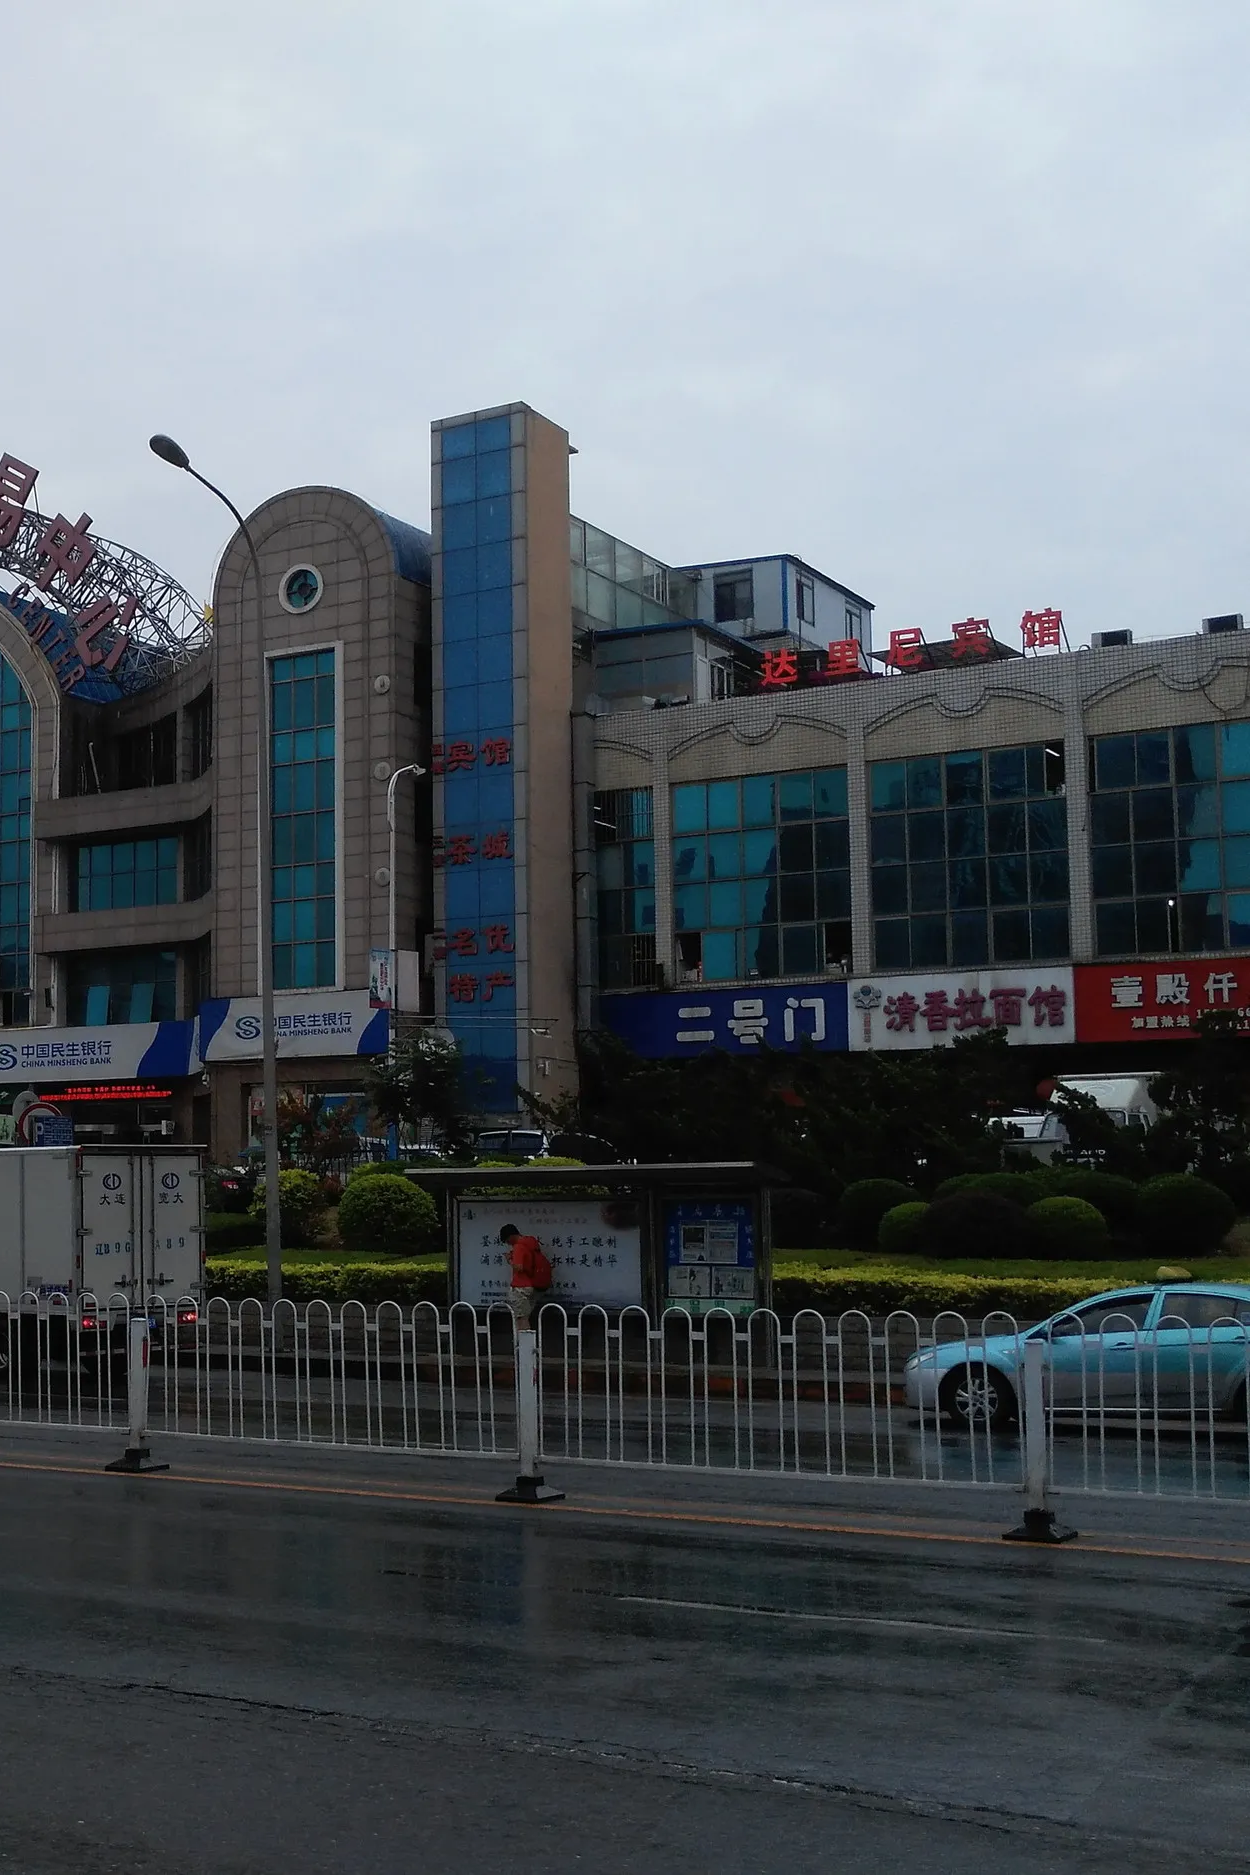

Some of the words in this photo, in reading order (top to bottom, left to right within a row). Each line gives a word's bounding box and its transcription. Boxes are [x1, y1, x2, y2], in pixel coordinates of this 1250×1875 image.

[7, 583, 86, 692] CENTER
[760, 608, 1062, 686] 达里尼宾馆
[446, 737, 511, 771] 宾馆
[449, 924, 515, 956] 名优
[448, 971, 515, 1003] 特产
[1110, 971, 1238, 1008] 壹殿仟
[676, 997, 826, 1044] 二号门
[883, 985, 1068, 1033] 清香拉面馆
[289, 1028, 329, 1036] MINSHENG
[331, 1026, 352, 1034] BANK
[21, 1040, 112, 1059] 中国民生银行
[21, 1060, 46, 1068] CHINA
[47, 1058, 88, 1067] MINSHENG
[90, 1056, 112, 1065] BANK
[100, 1193, 126, 1206] 大连
